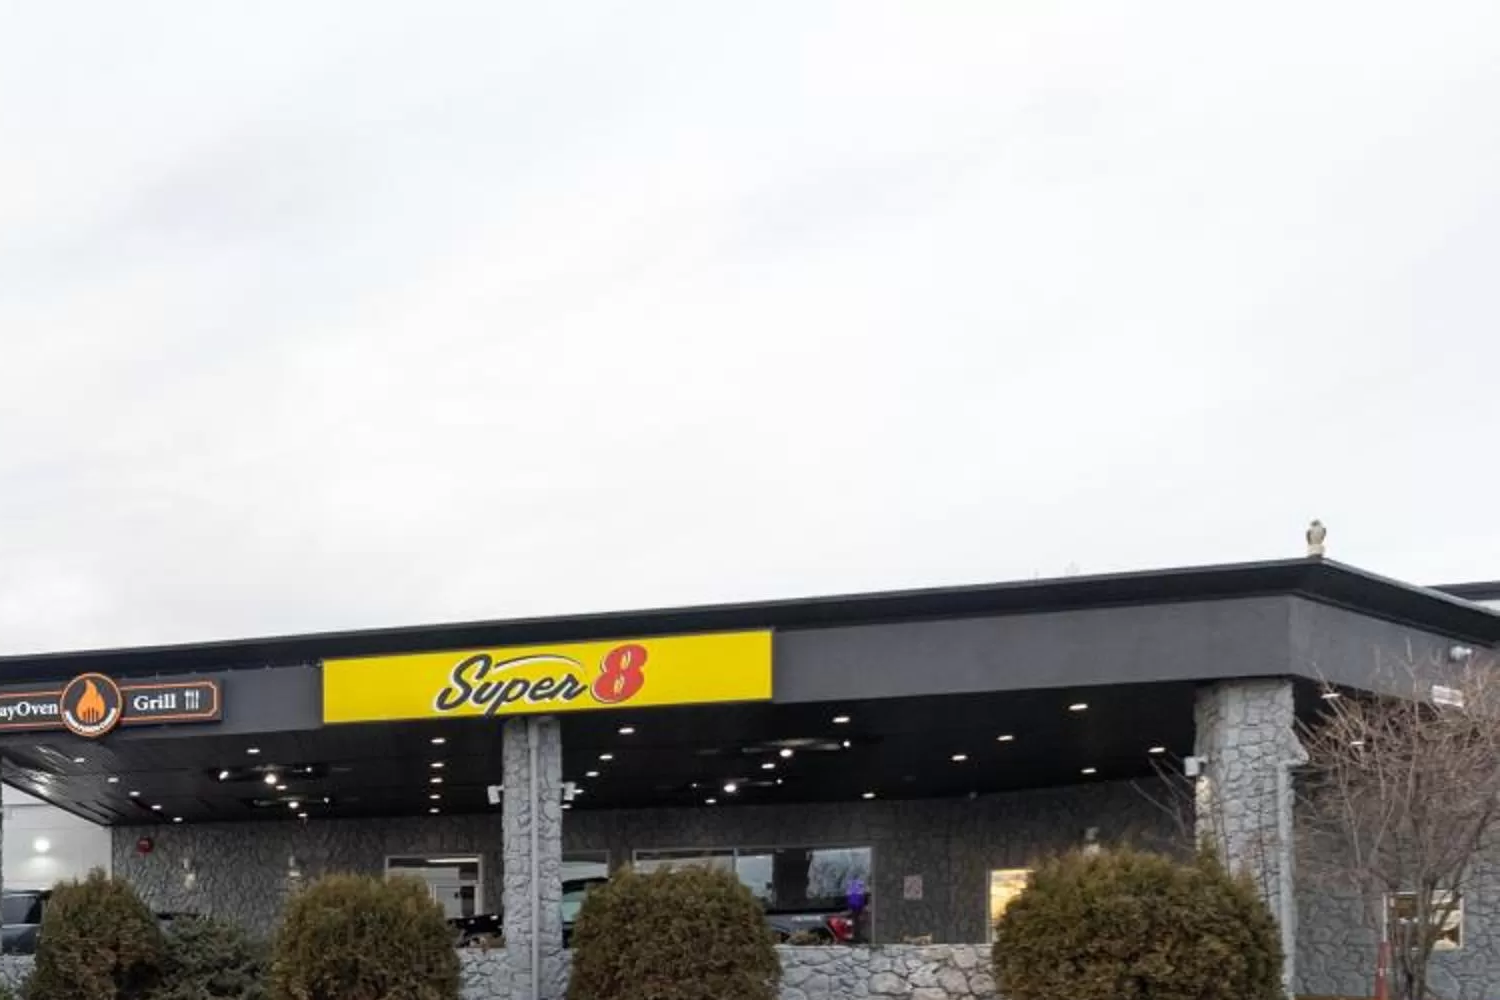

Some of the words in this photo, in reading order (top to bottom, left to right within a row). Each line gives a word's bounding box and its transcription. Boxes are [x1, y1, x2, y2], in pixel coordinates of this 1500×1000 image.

[133, 692, 177, 711] Grill
[434, 653, 588, 718] Super
[591, 644, 648, 704] 8
